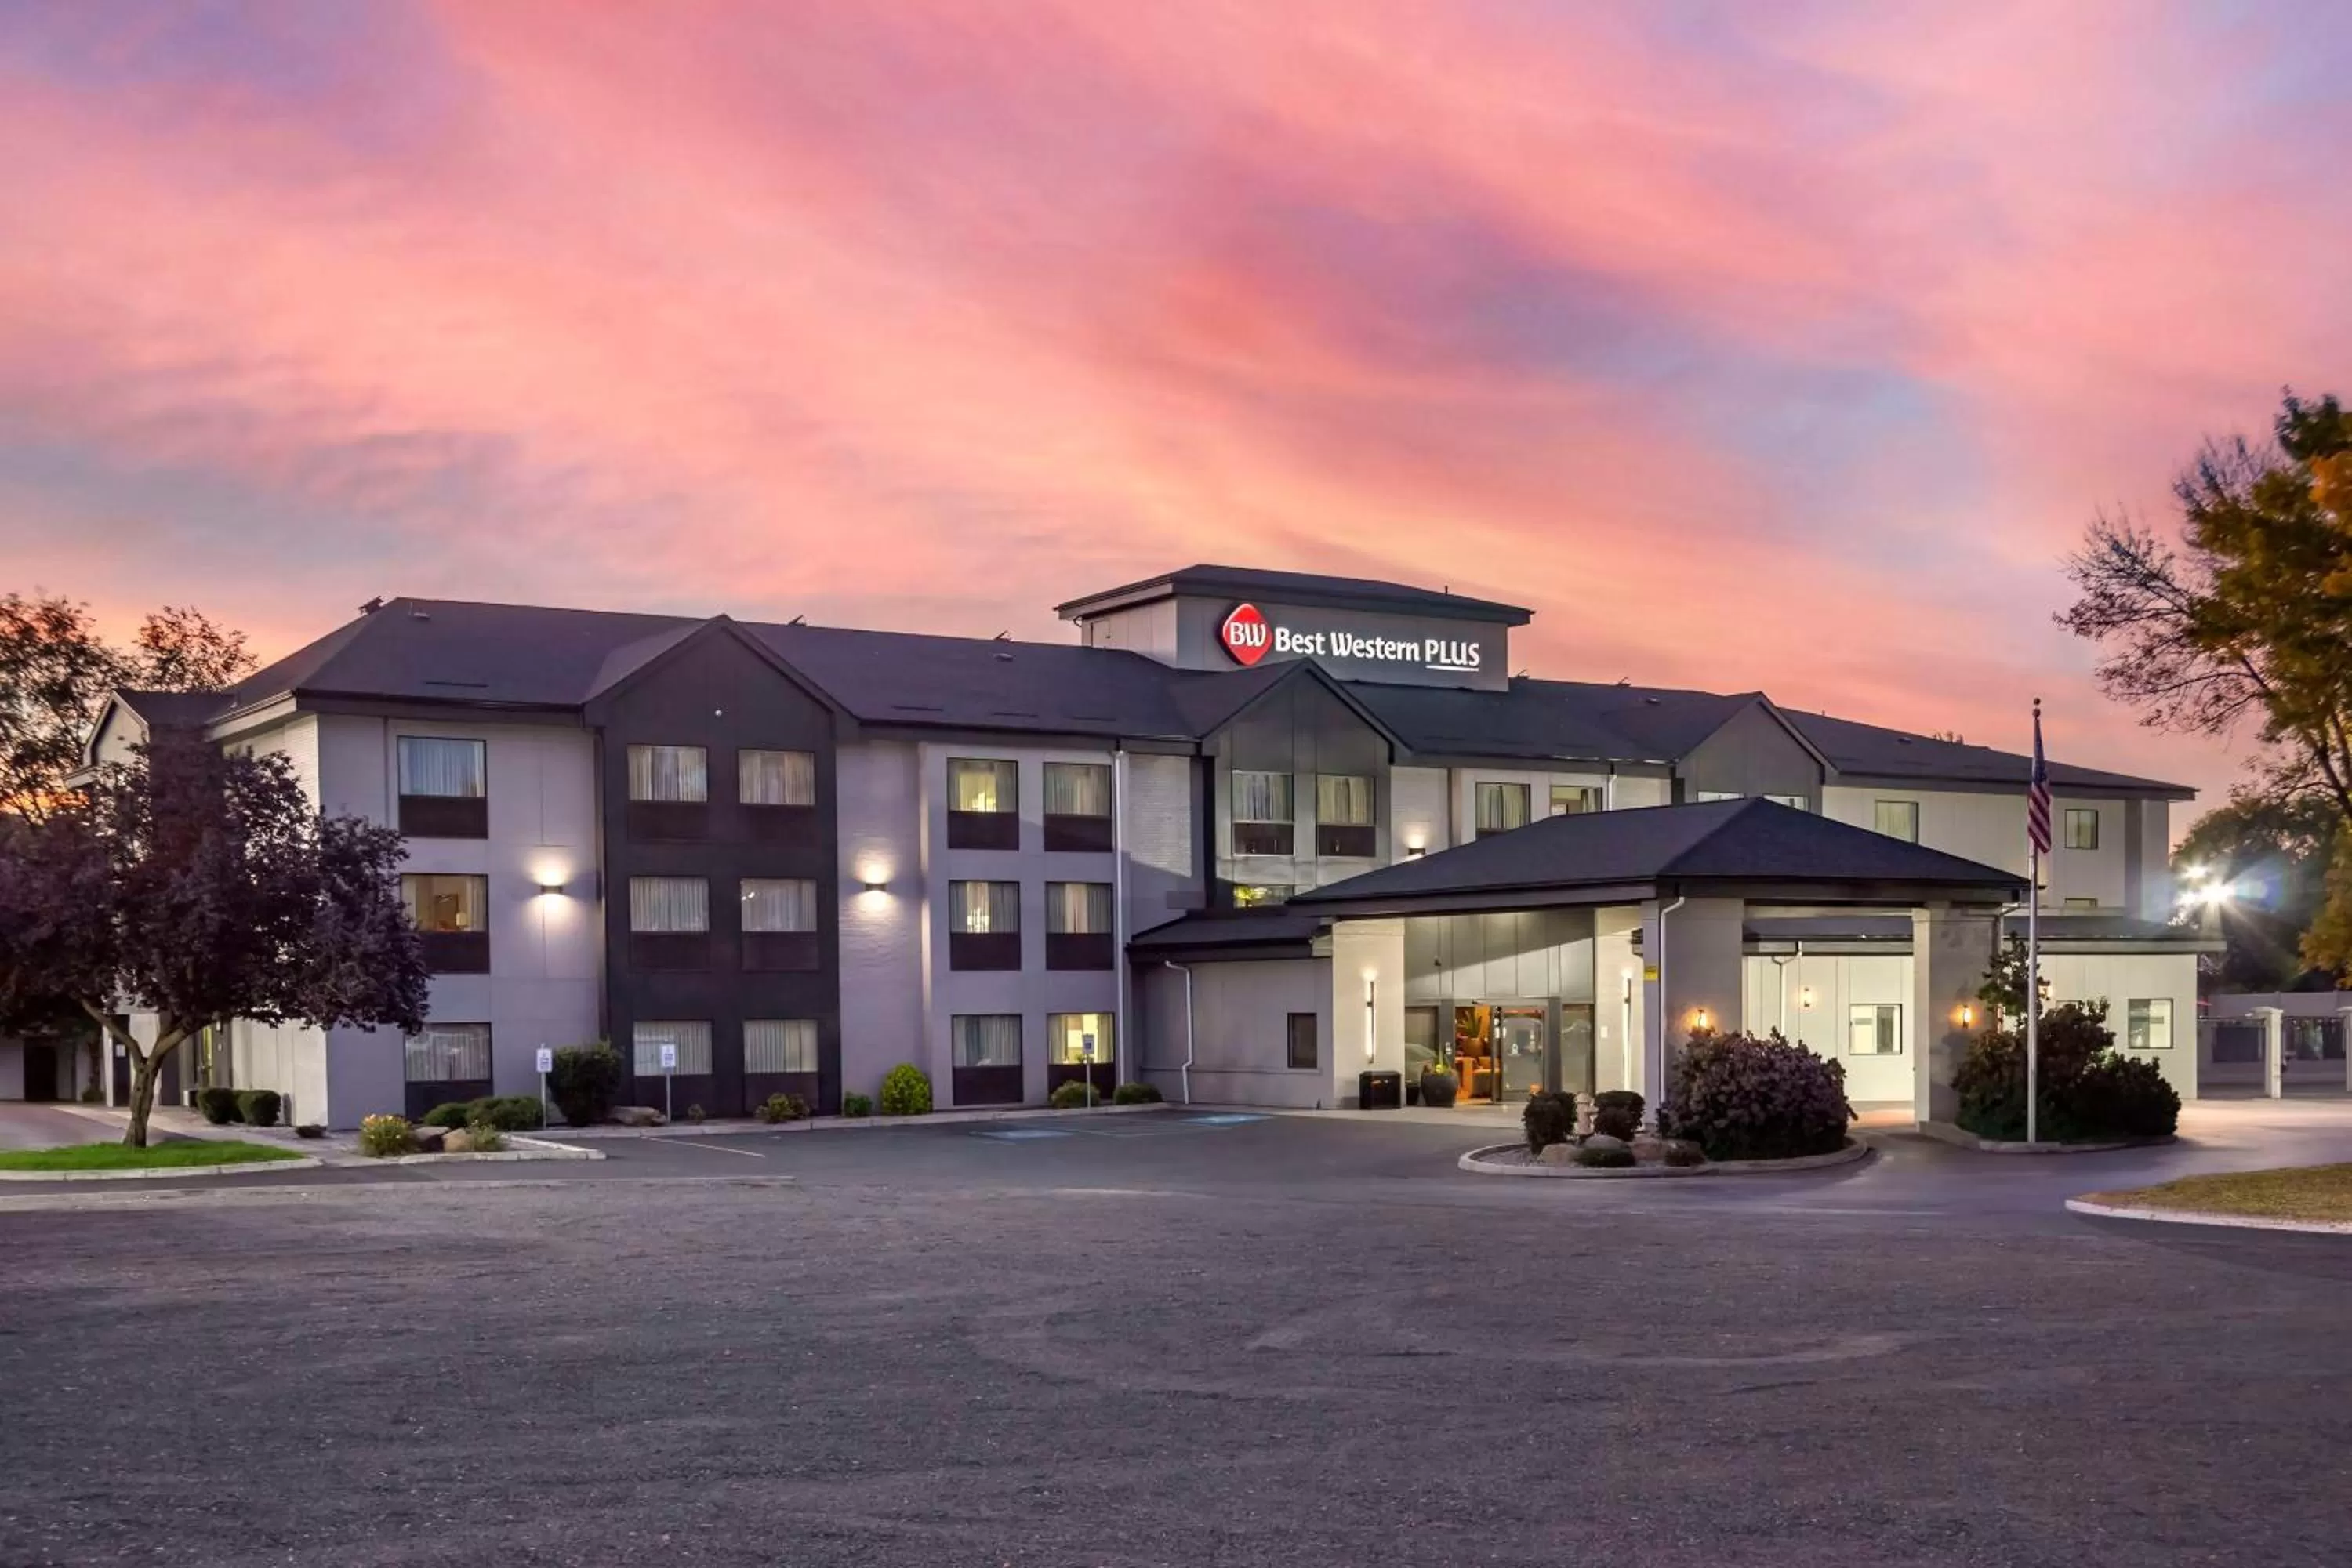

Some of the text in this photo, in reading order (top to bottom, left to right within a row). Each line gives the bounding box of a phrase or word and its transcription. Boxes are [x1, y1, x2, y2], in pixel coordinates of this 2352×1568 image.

[1229, 622, 1266, 647] BW
[1275, 626, 1480, 666] Best Western PLUS
